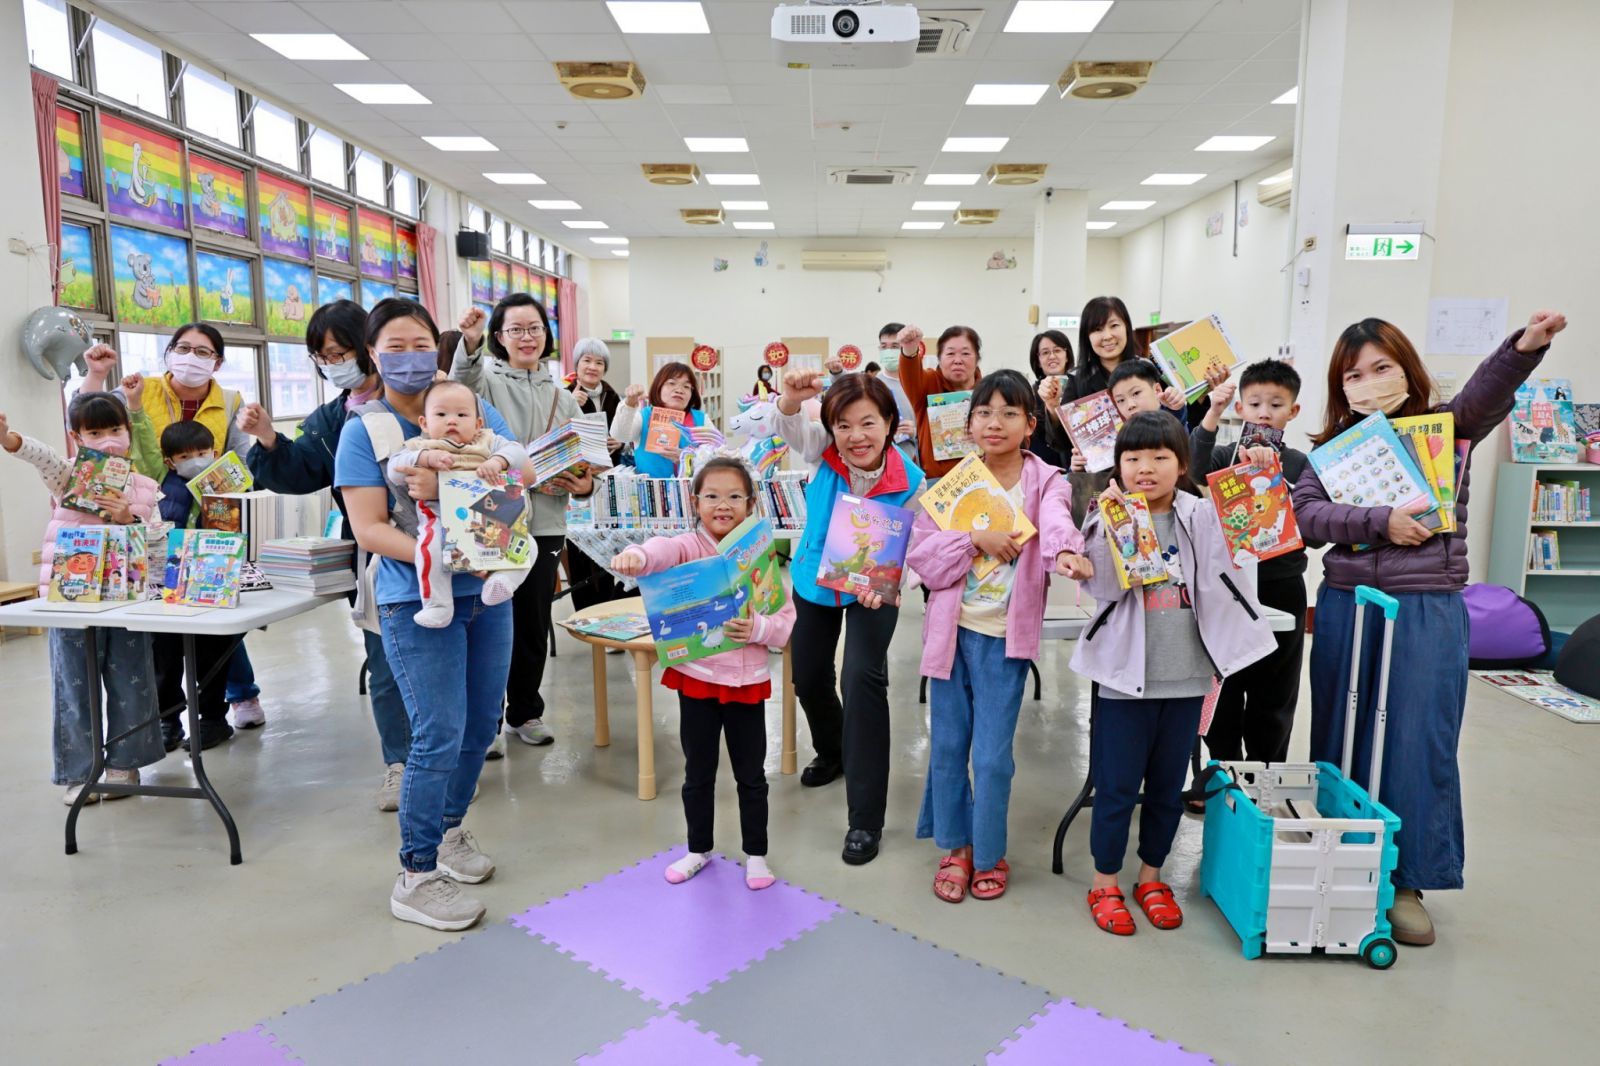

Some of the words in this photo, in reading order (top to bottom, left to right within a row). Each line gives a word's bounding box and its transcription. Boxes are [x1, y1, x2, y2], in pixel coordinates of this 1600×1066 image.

[697, 350, 710, 366] 意
[768, 349, 785, 362] 如
[934, 471, 965, 499] 星期三的
[950, 470, 980, 498] 麵包店
